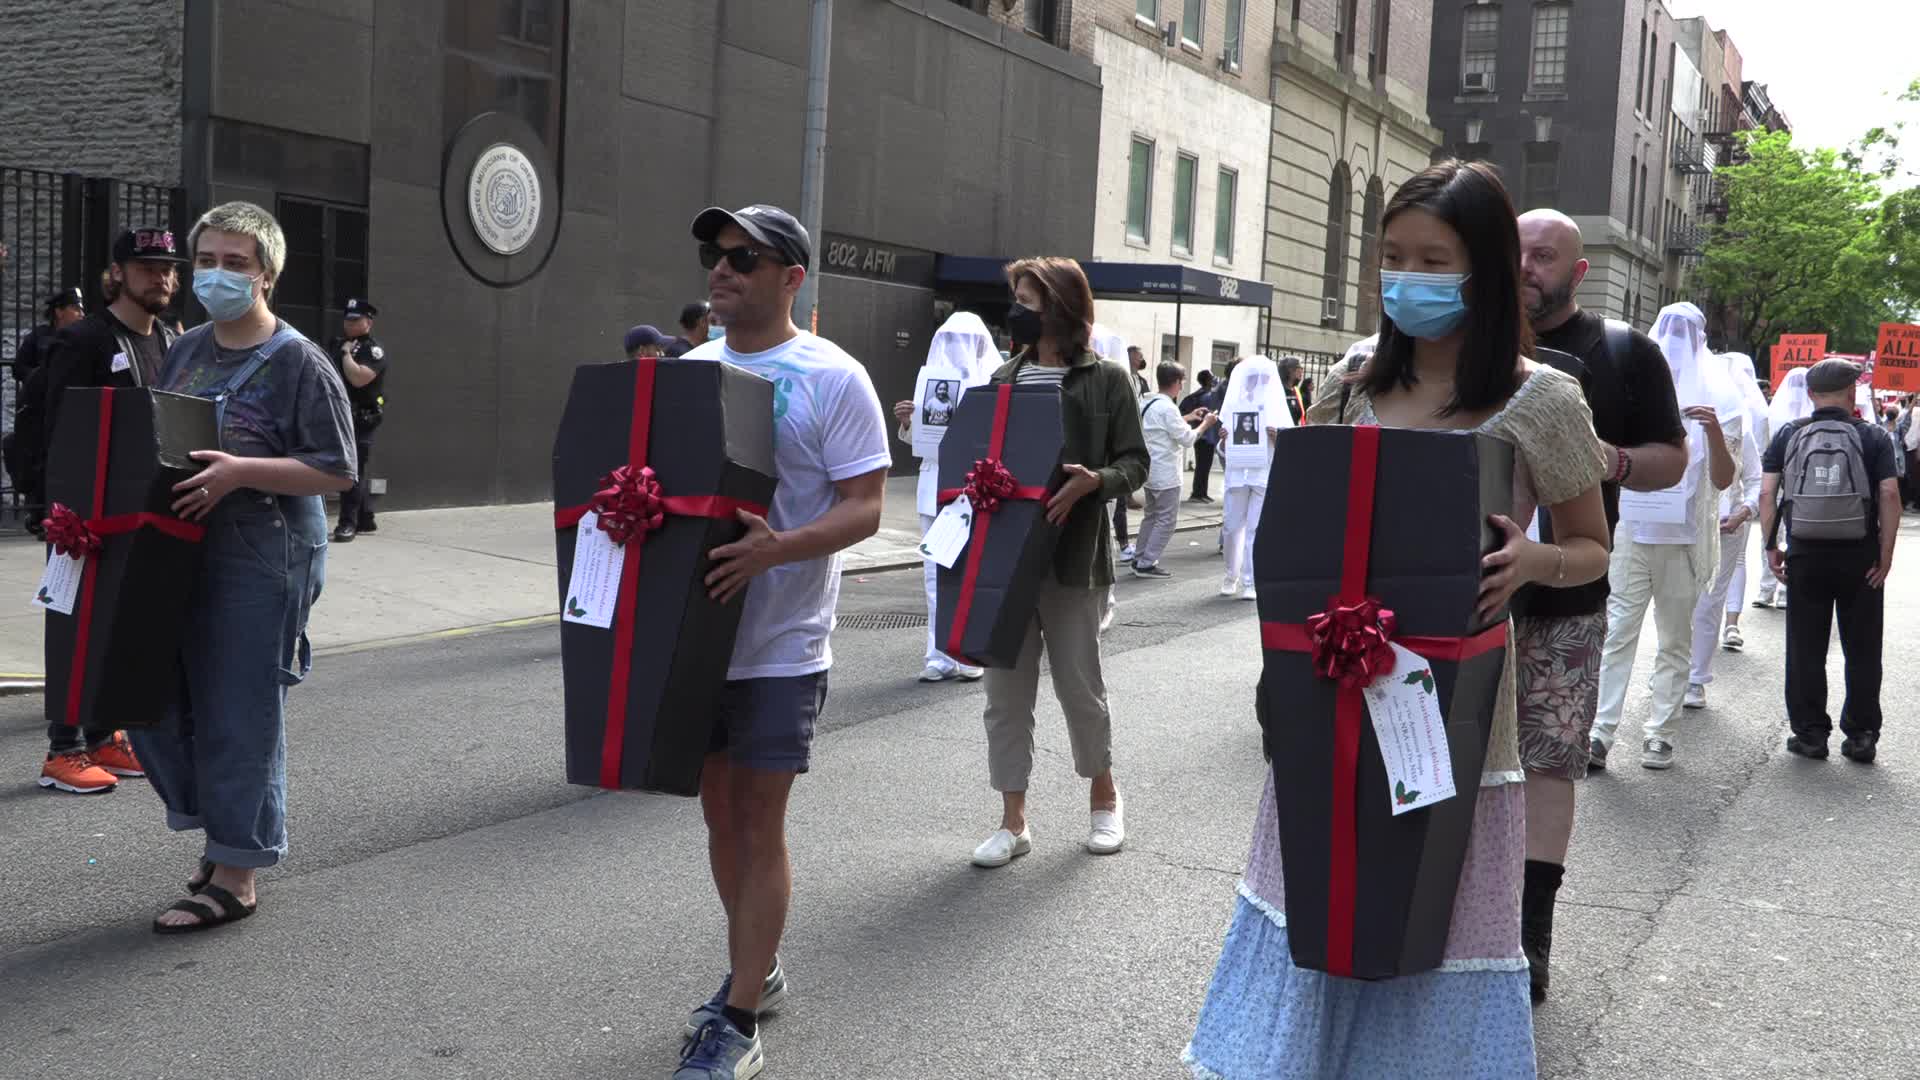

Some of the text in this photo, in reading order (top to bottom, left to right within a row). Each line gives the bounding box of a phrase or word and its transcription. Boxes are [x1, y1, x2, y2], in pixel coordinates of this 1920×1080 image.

[477, 153, 506, 184] MUSICIANS
[509, 154, 518, 162] OF
[519, 163, 536, 201] GREATER
[827, 241, 897, 273] 802 AFM
[1887, 328, 1900, 337] WE
[1784, 347, 1817, 361] ALL
[1882, 339, 1920, 358] ALL
